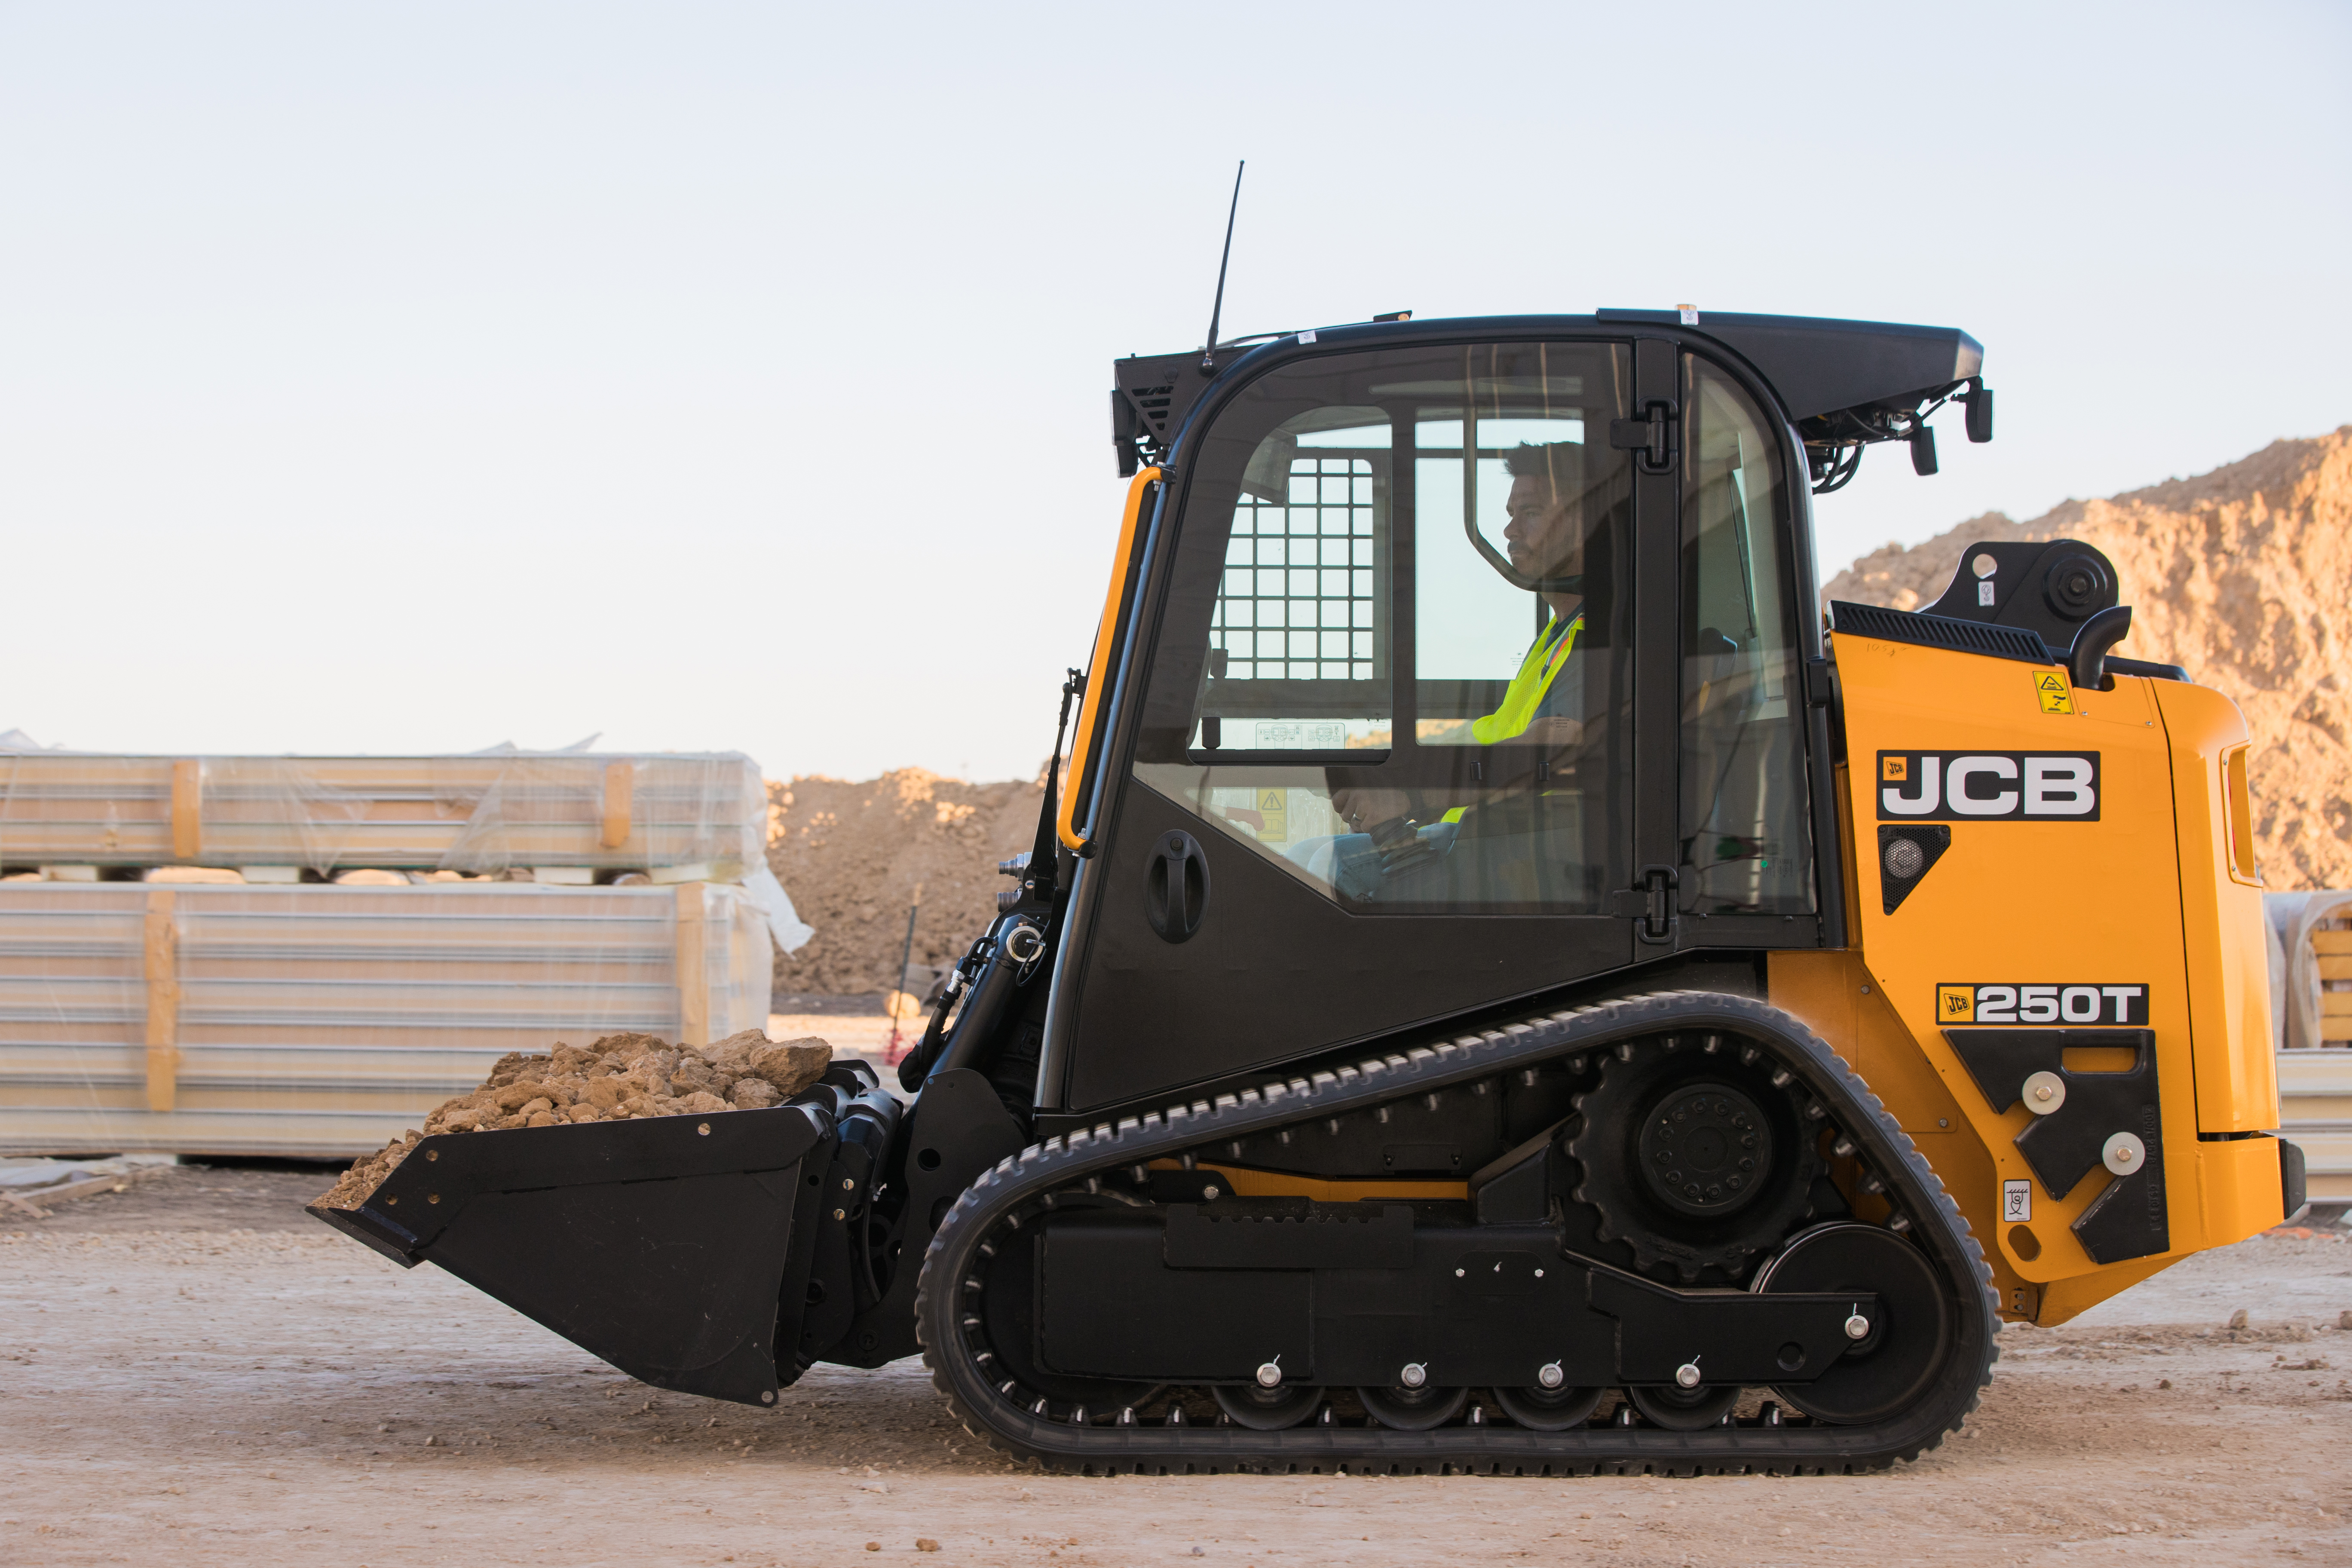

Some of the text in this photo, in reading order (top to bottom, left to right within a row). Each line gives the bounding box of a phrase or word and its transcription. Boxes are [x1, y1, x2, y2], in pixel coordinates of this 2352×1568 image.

[1890, 763, 1902, 774] JCB
[1883, 756, 2095, 815] JCB
[1948, 996, 1968, 1013] JCB
[1977, 986, 2141, 1022] 250T
